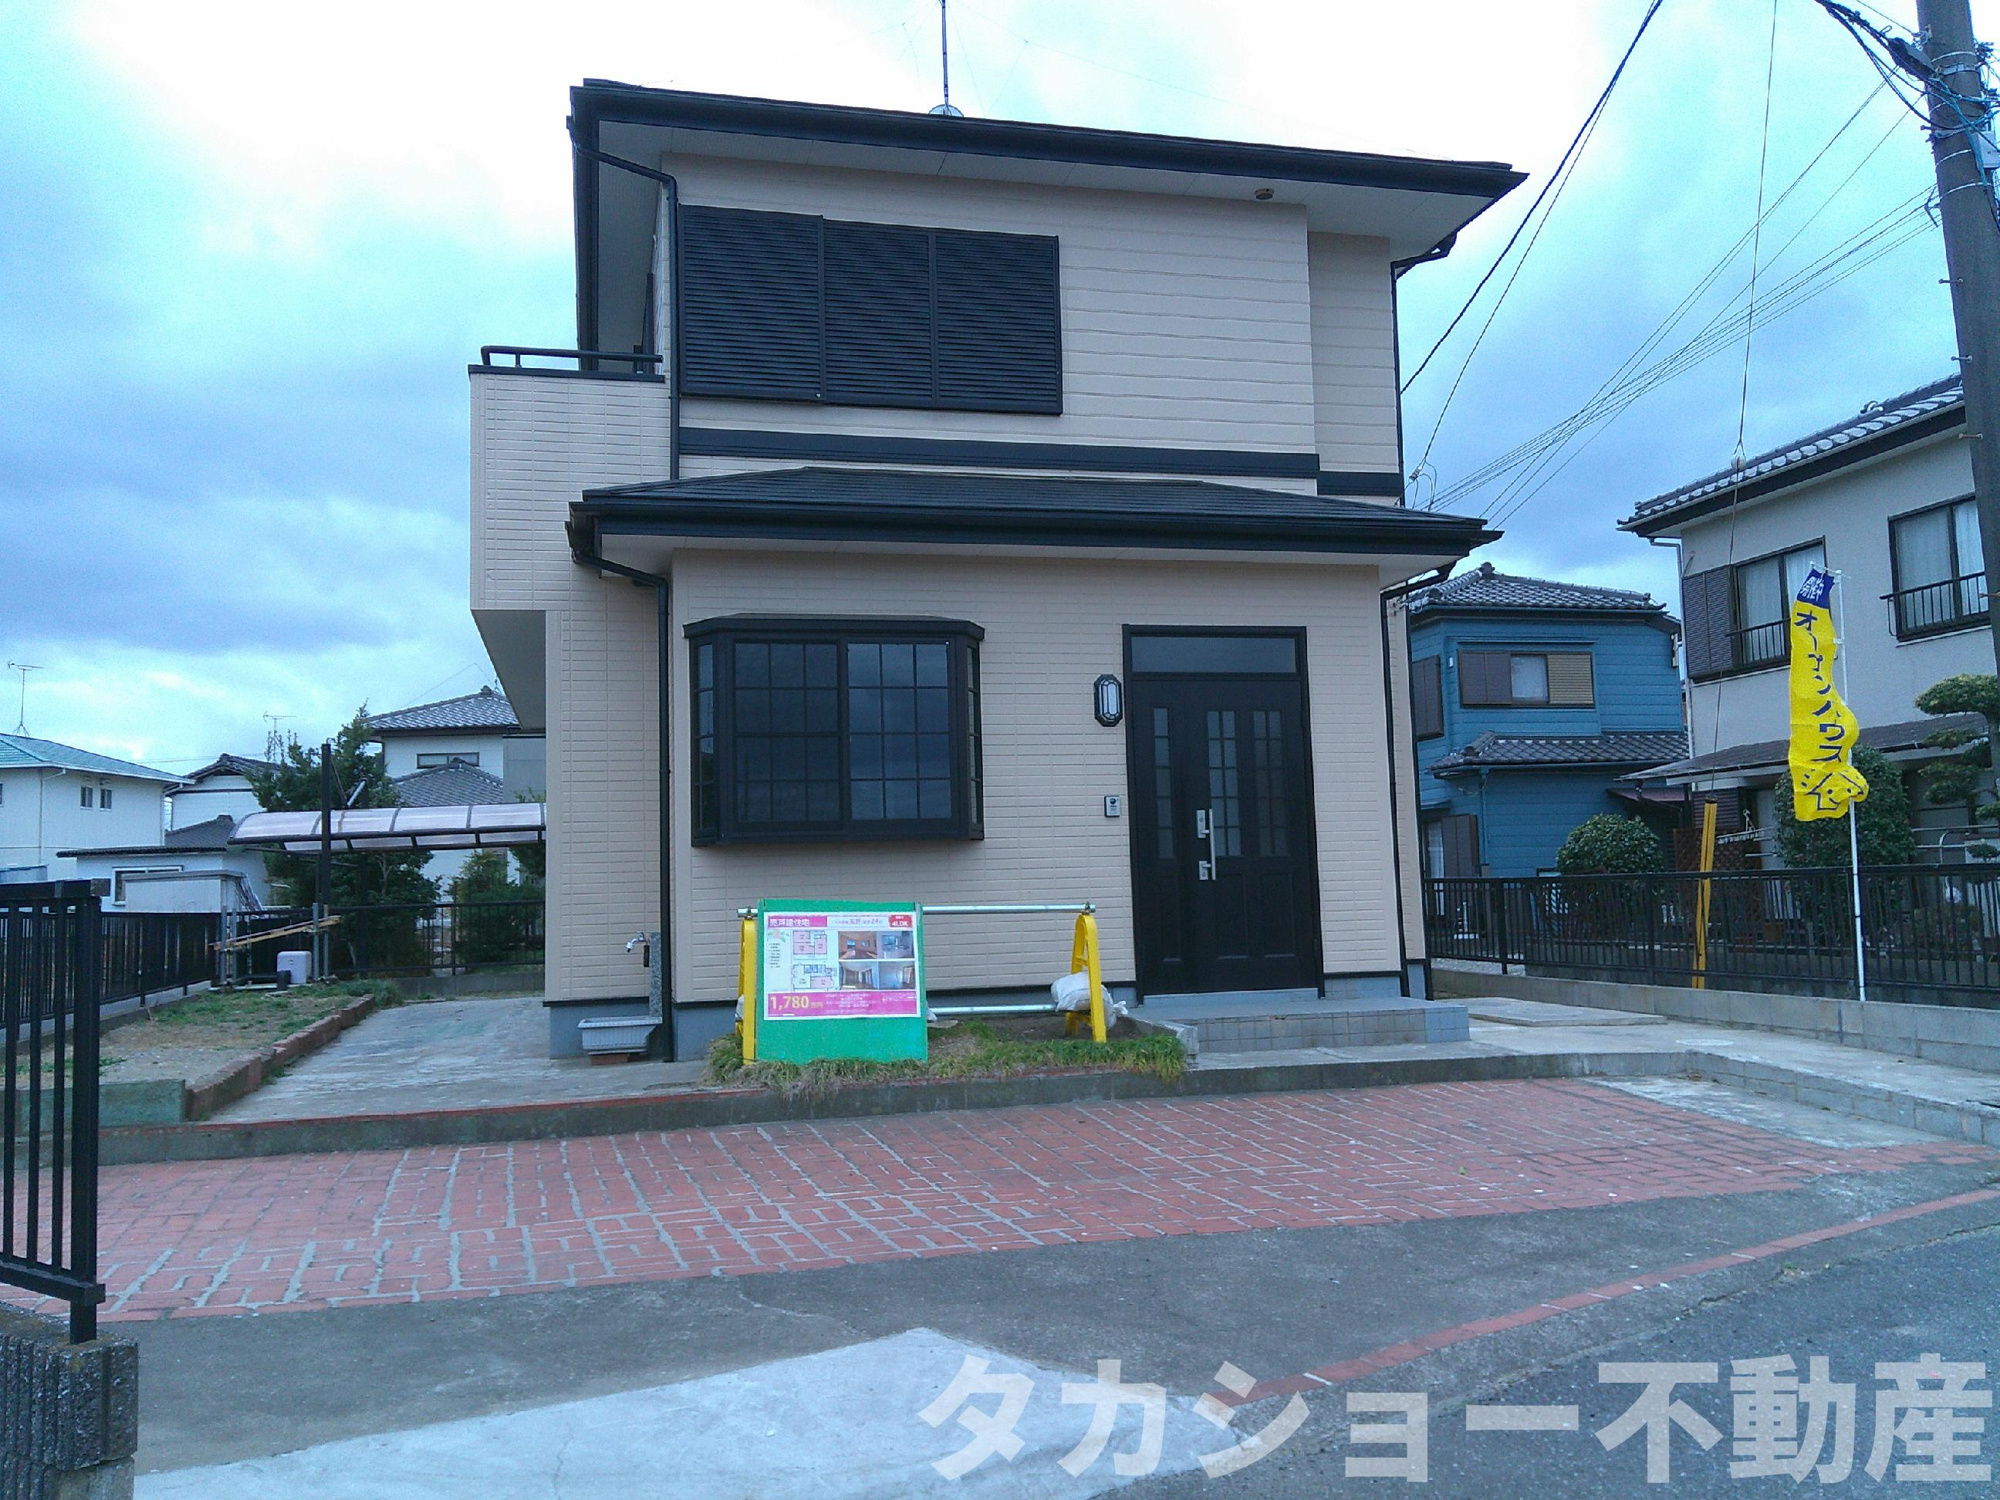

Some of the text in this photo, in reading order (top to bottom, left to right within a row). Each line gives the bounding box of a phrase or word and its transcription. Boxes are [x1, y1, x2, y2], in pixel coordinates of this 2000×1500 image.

[1794, 610, 1846, 764] オープンハウス
